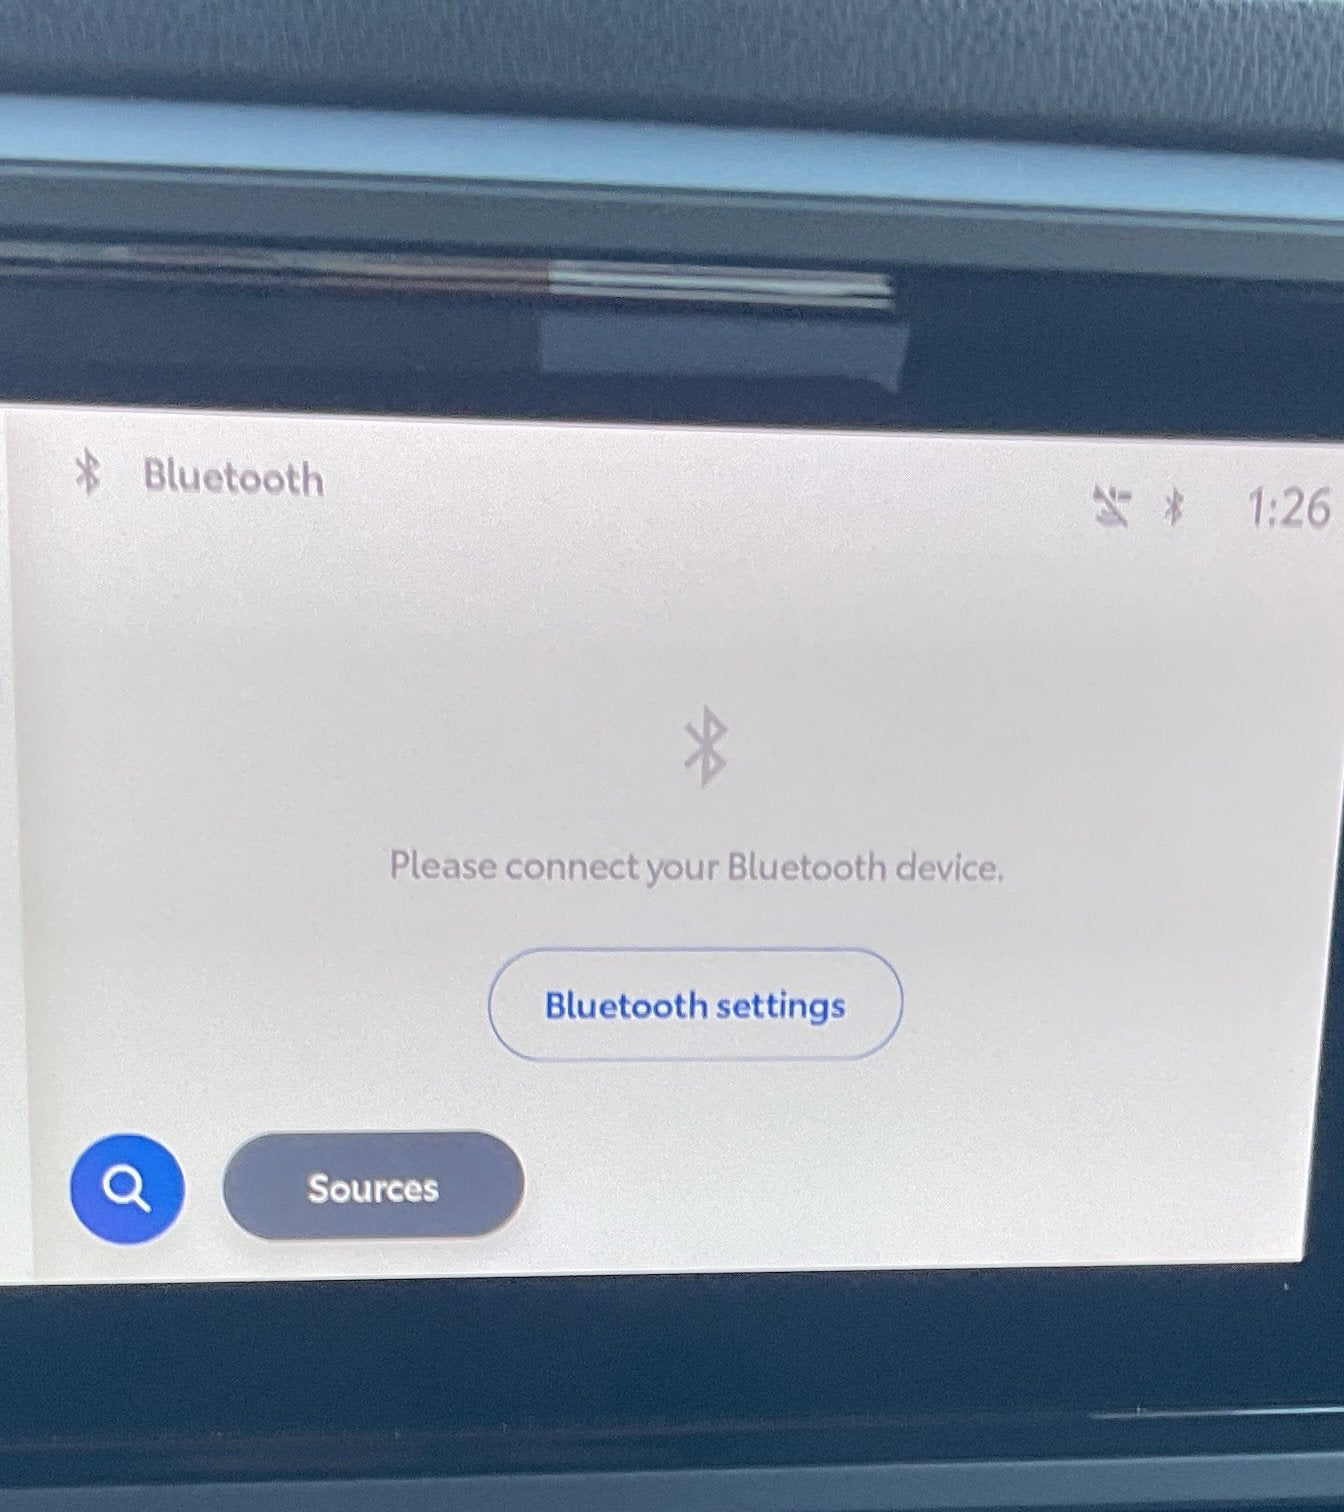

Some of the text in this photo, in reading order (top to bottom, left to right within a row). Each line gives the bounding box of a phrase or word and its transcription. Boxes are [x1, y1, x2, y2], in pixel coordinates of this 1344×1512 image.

[143, 457, 324, 497] Bluetooth
[1248, 486, 1331, 529] 1:26
[391, 848, 1004, 889] Please connect your Bluetooth device.
[546, 990, 846, 1026] Bluetooth settings
[307, 1172, 440, 1204] Sources
